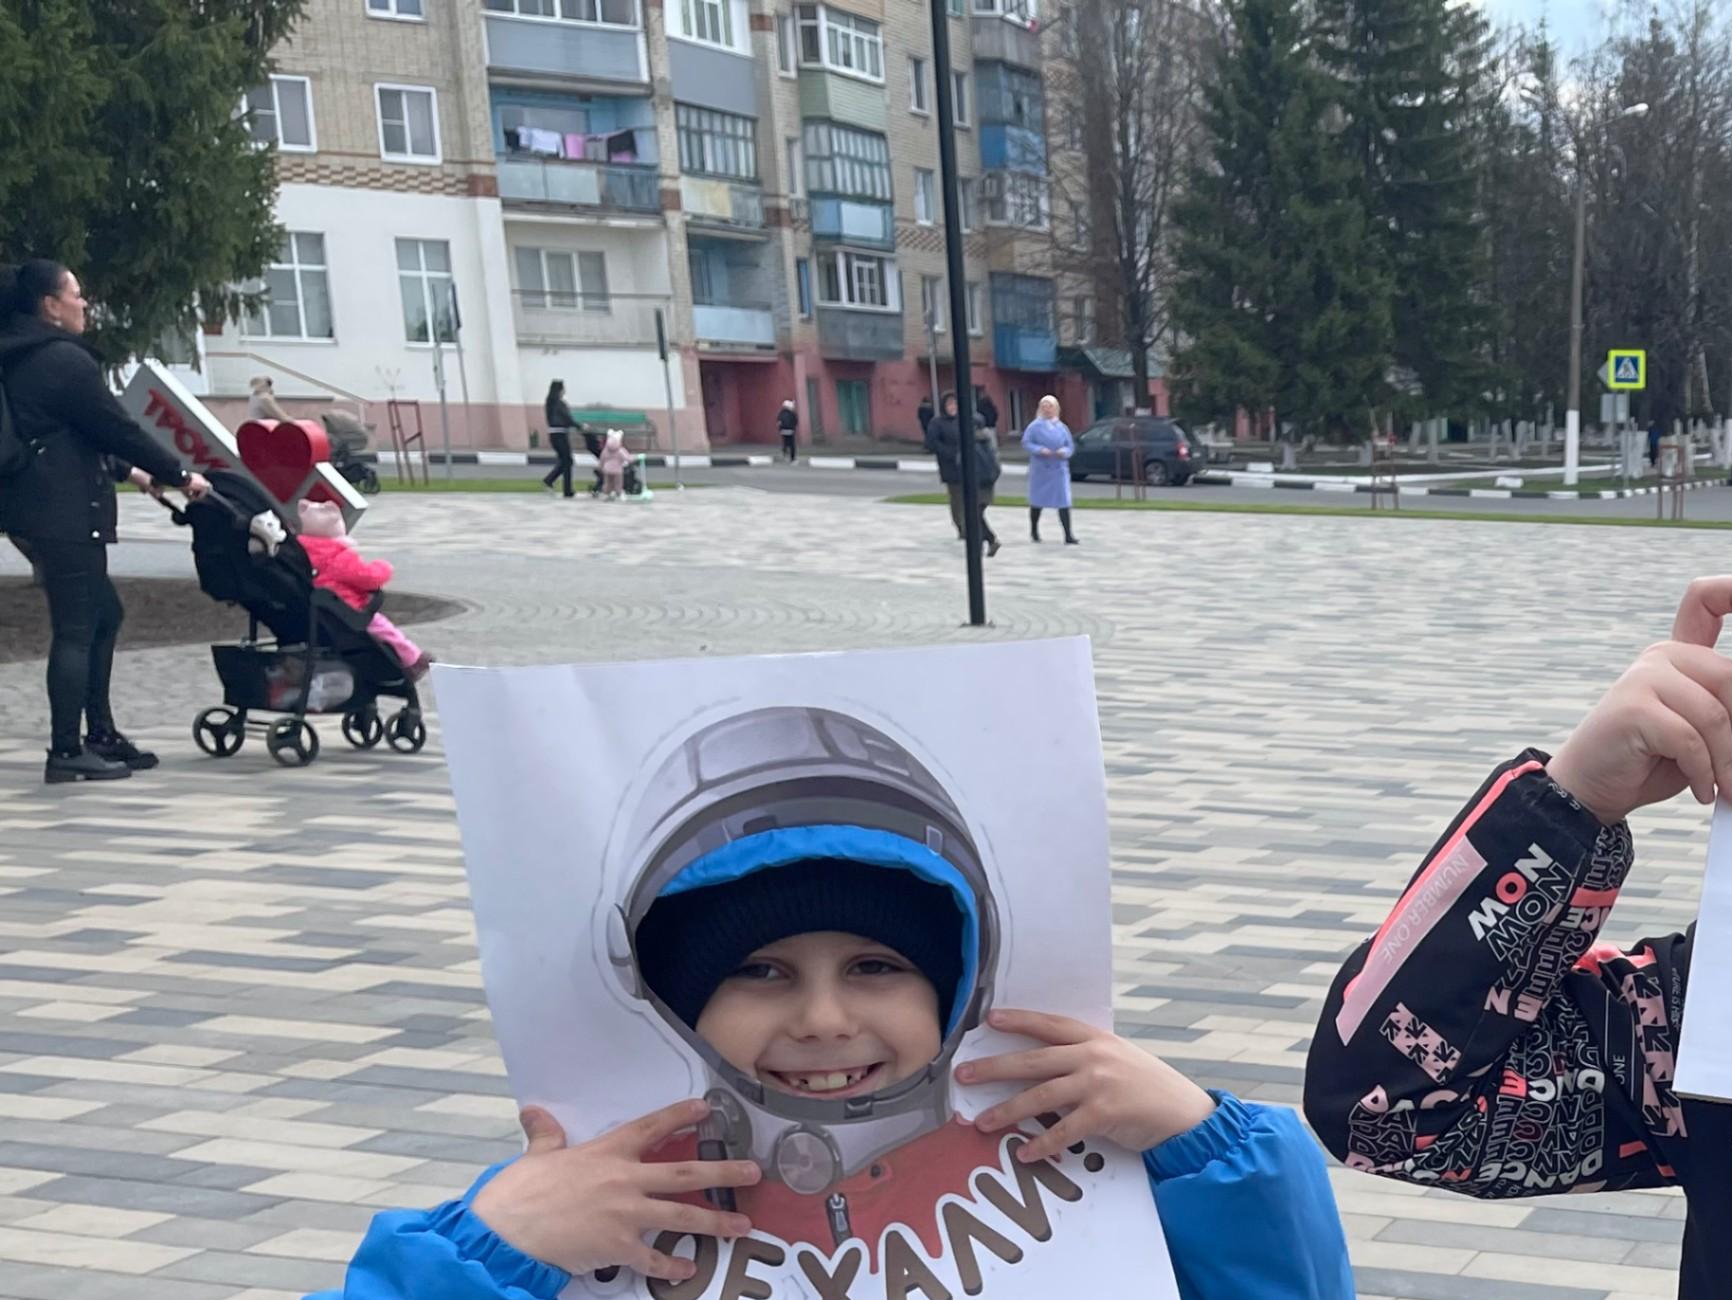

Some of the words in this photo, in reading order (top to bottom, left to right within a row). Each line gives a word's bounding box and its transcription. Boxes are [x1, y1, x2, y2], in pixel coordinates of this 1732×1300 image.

[1408, 854, 1469, 927] NUMBER
[1468, 842, 1554, 941] NOW
[1382, 928, 1411, 965] ONE
